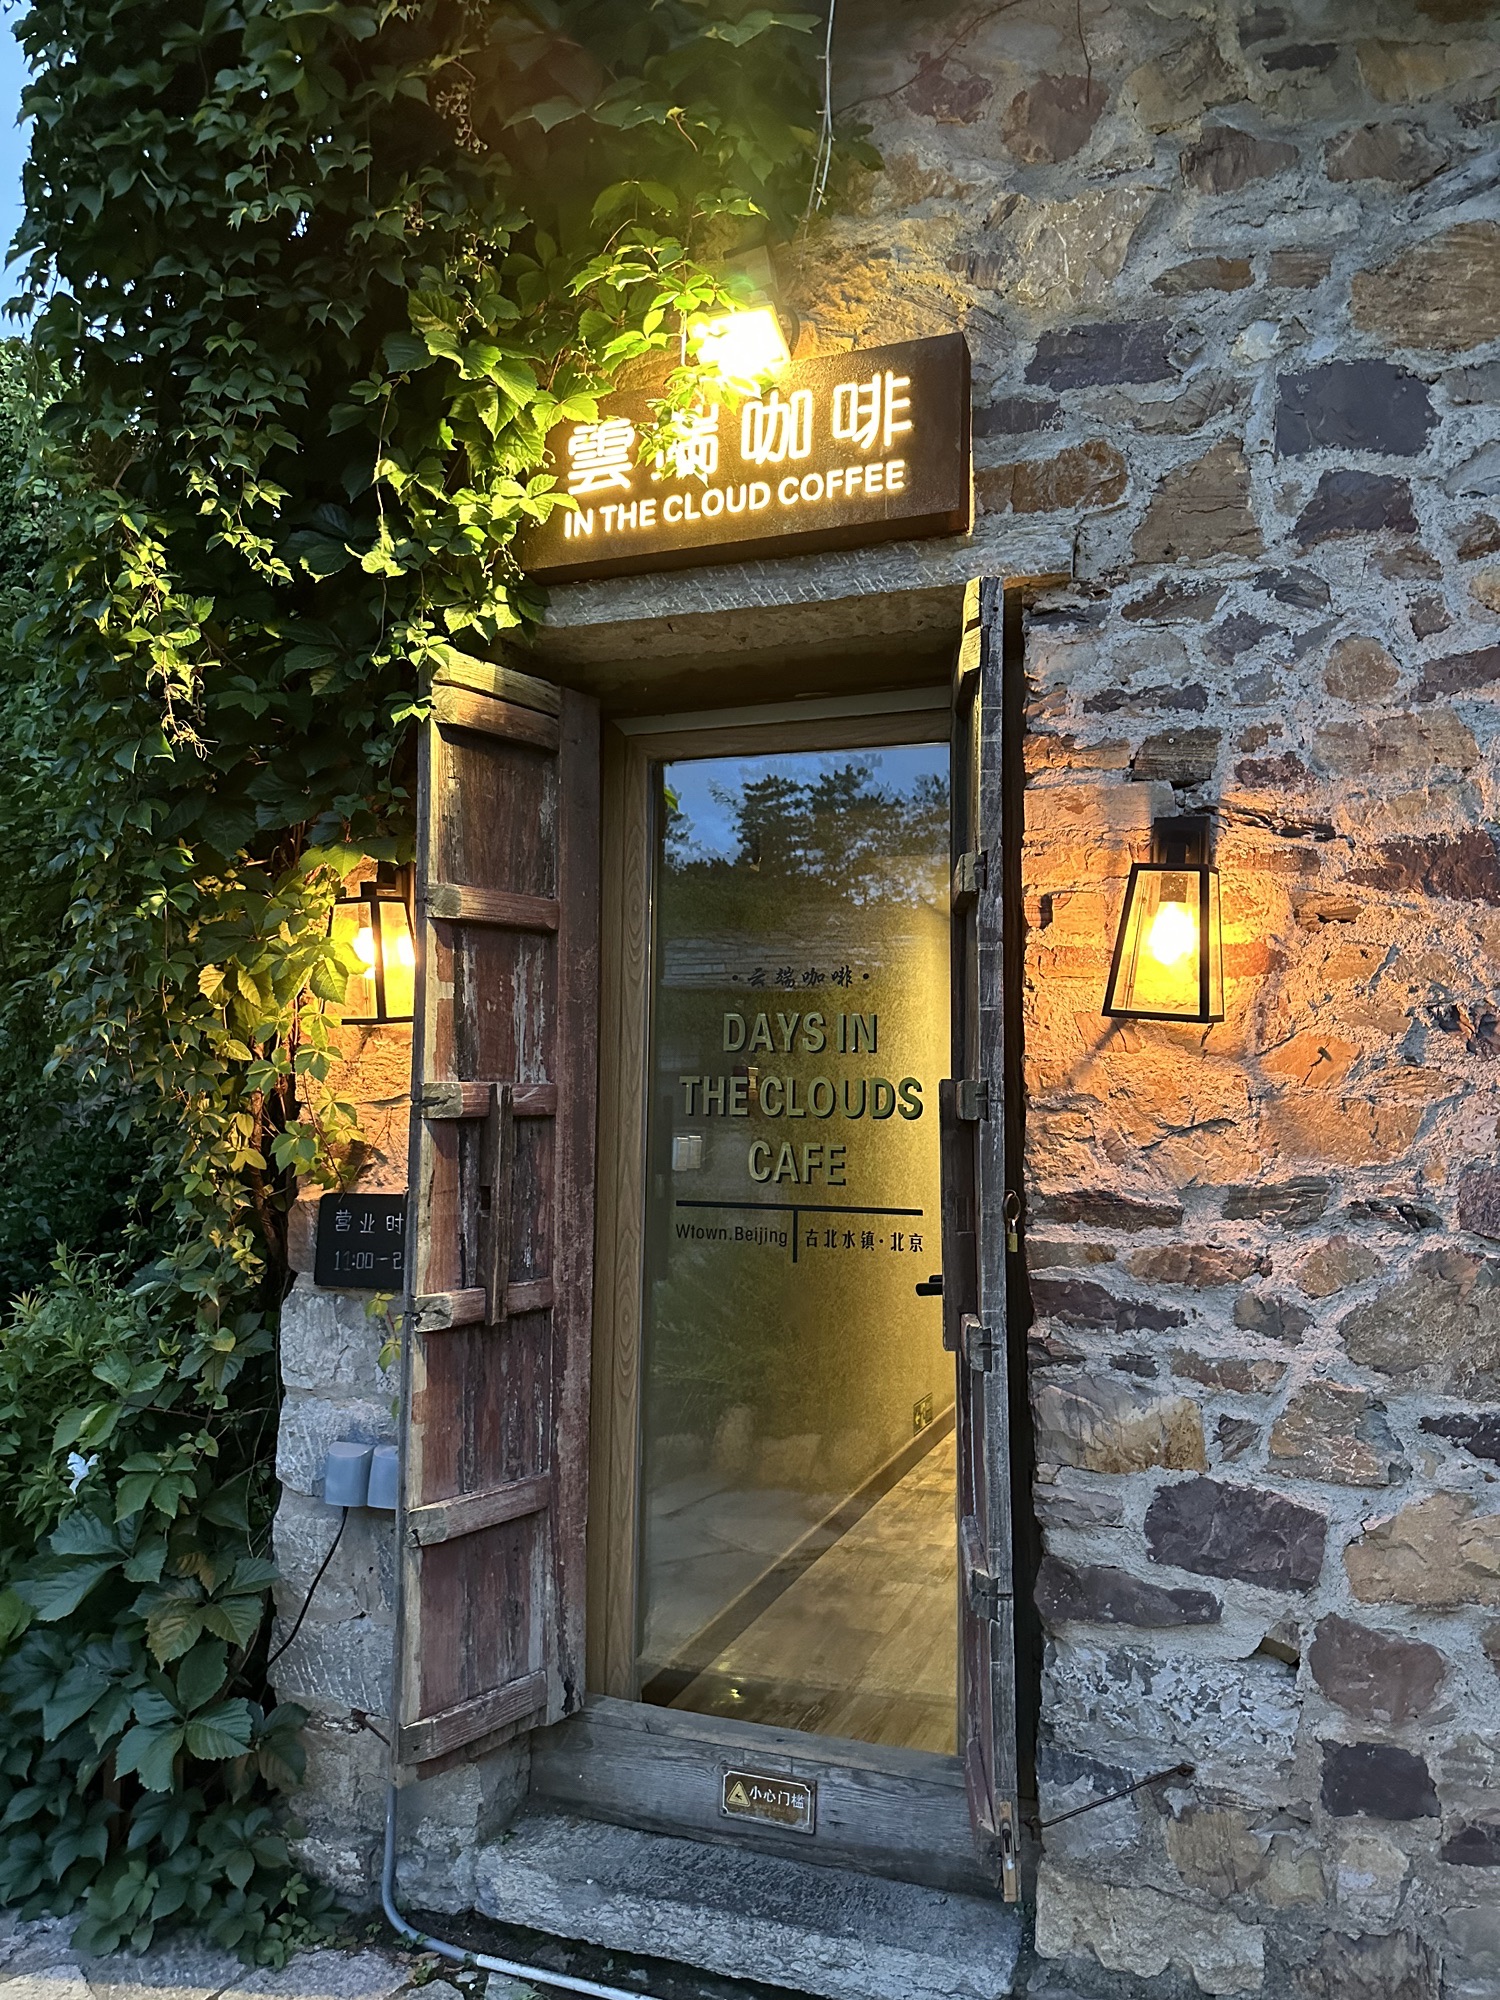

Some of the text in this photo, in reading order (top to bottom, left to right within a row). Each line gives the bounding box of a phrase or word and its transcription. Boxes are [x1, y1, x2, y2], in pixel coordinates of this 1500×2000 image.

[564, 459, 906, 538] IN THE CLOUD COFFEE
[722, 1011, 878, 1054] DAYS IN
[678, 1075, 924, 1121] THE CLOUDS
[748, 1140, 847, 1186] CAFE
[335, 1208, 404, 1235] 营业时
[675, 1223, 788, 1248] Wtown.Beijing
[333, 1249, 404, 1271] 11:00-2
[749, 1785, 805, 1809] 小心门槛
